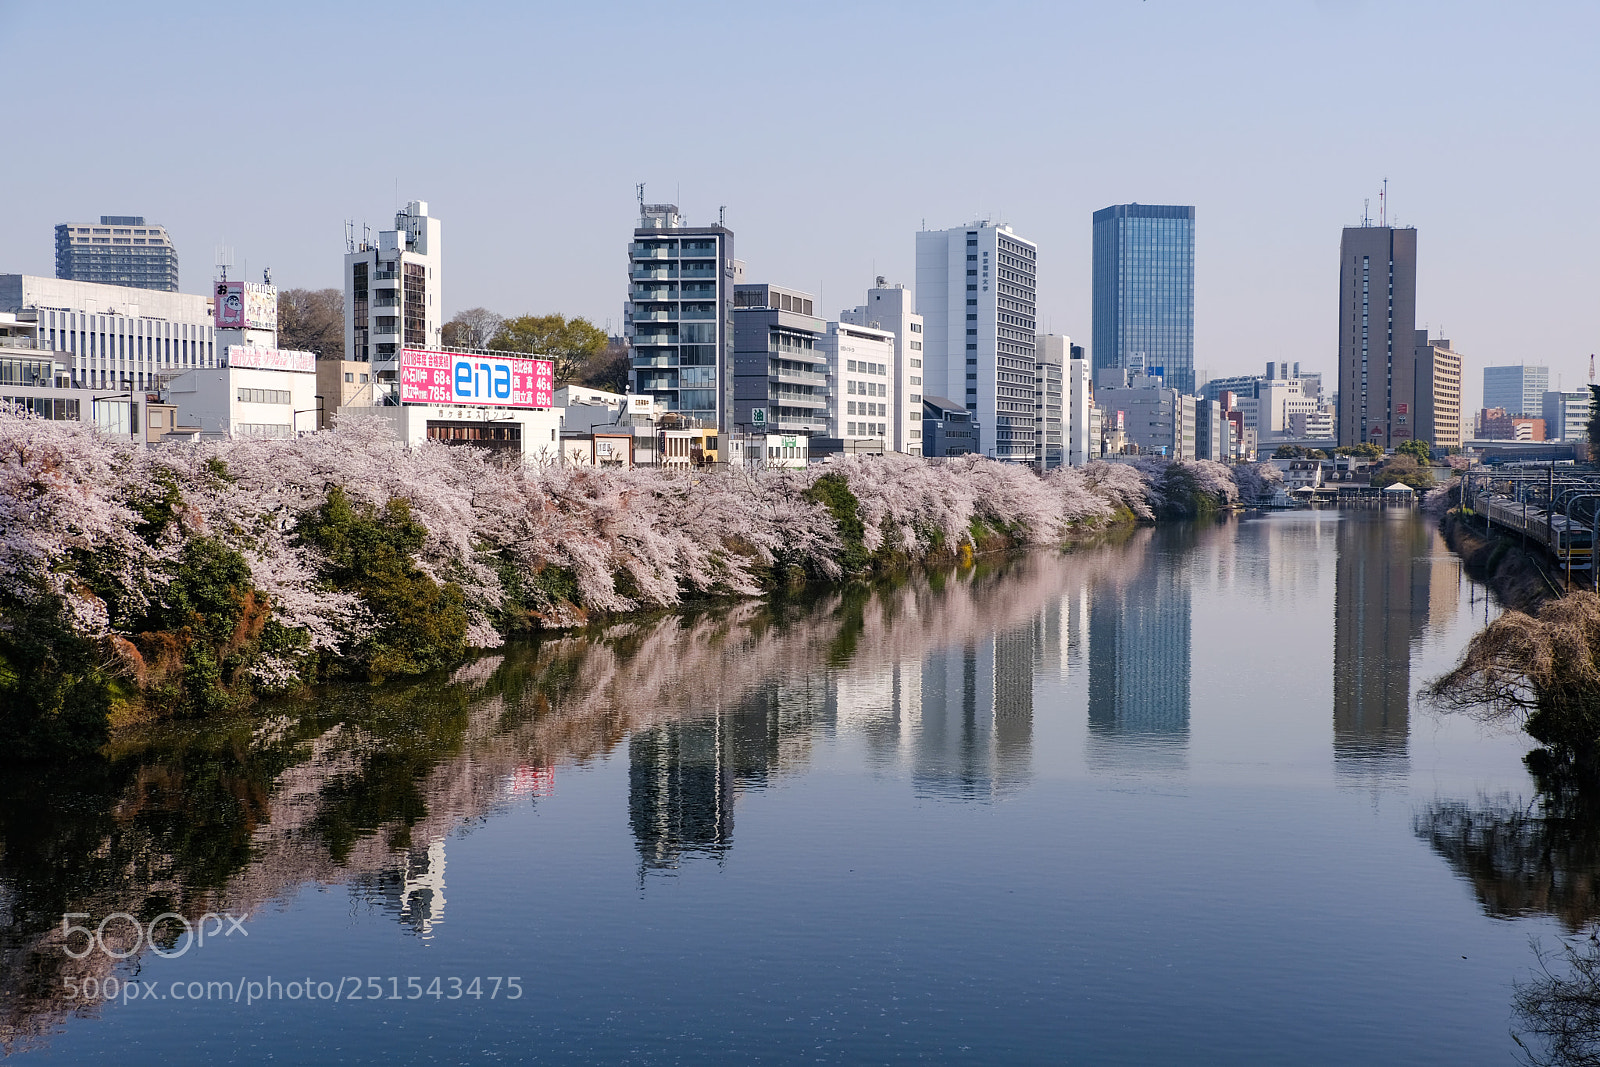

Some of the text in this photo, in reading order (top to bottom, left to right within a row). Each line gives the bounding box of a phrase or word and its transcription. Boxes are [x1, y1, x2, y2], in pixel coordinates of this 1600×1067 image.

[218, 284, 228, 295] お
[245, 282, 276, 300] orange
[404, 352, 450, 368] 2018年度 合格実績
[402, 368, 428, 383] 小石川中
[454, 362, 510, 398] ena
[513, 390, 532, 404] 国立高
